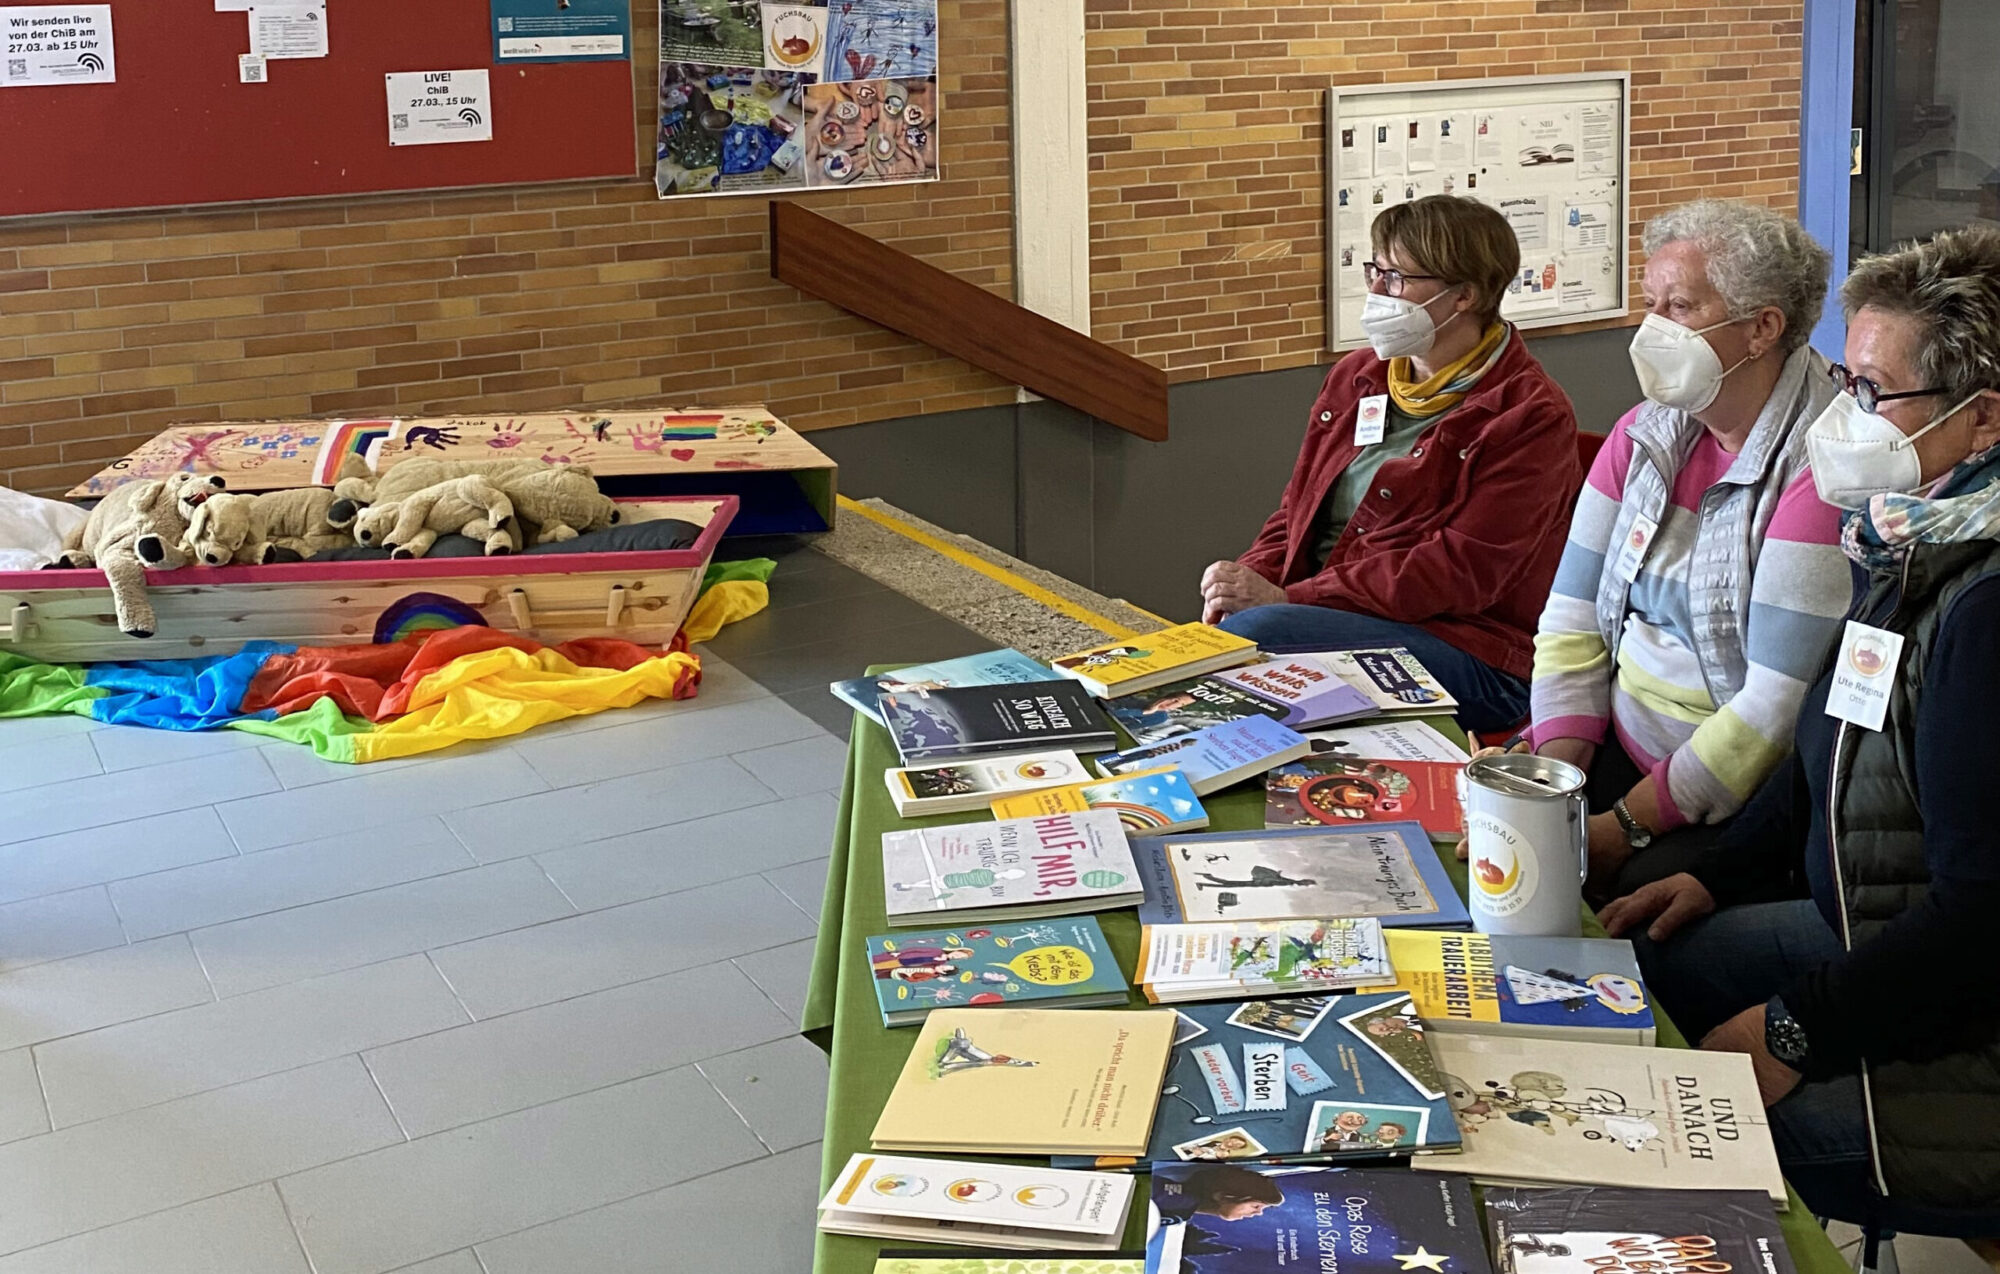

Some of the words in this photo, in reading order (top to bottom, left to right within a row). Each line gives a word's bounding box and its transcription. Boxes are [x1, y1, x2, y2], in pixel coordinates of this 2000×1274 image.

[10, 18, 29, 27] Wir
[31, 16, 71, 26] senden
[73, 15, 92, 24] live
[8, 32, 28, 40] von
[31, 30, 48, 39] der
[51, 28, 76, 38] ChiB
[79, 29, 96, 37] am
[8, 43, 43, 53] 27.03.
[46, 42, 60, 51] ab
[63, 41, 77, 50] 15
[80, 40, 99, 49] Uhr
[424, 73, 451, 83] LIVE!
[427, 86, 449, 95] ChiB
[446, 97, 458, 105] 15
[460, 96, 477, 104] Uhr
[1186, 684, 1235, 705] Tod?
[1838, 676, 1854, 688] Ute
[1855, 682, 1884, 699] Regina
[1011, 699, 1033, 710] SO
[1035, 695, 1072, 729] EINFACH
[1021, 710, 1047, 730] WEG
[999, 824, 1017, 850] WENN
[1033, 815, 1087, 850] HILF
[1002, 850, 1020, 864] ICH
[1367, 836, 1388, 855] Mein
[976, 837, 999, 868] TRAURIG
[990, 886, 1004, 898] BIN
[1031, 854, 1077, 896] MIR,
[1376, 856, 1400, 889] trauriges
[1387, 890, 1422, 911] Buch
[1023, 953, 1047, 983] Krebs?
[1046, 953, 1059, 964] mit
[1060, 949, 1075, 959] Wie
[1070, 969, 1084, 979] das
[1467, 937, 1497, 1000] TABUTHEMA
[1051, 964, 1065, 980] dem
[1440, 936, 1472, 1019] TRAUERARBEIT
[1106, 1066, 1117, 1081] man
[1201, 1050, 1222, 1078] wieder
[1215, 1078, 1240, 1108] vorbei?
[1253, 1053, 1279, 1101] Sterben
[1290, 1063, 1316, 1084] Geht
[1675, 1075, 1714, 1161] DANACH
[1710, 1098, 1740, 1141] UND
[1314, 1192, 1330, 1205] zu
[1341, 1196, 1368, 1222] Opas
[1315, 1208, 1338, 1227] den
[1348, 1224, 1372, 1255] Reise
[1318, 1229, 1341, 1274] Sternen
[1652, 1234, 1733, 1274] PAP
